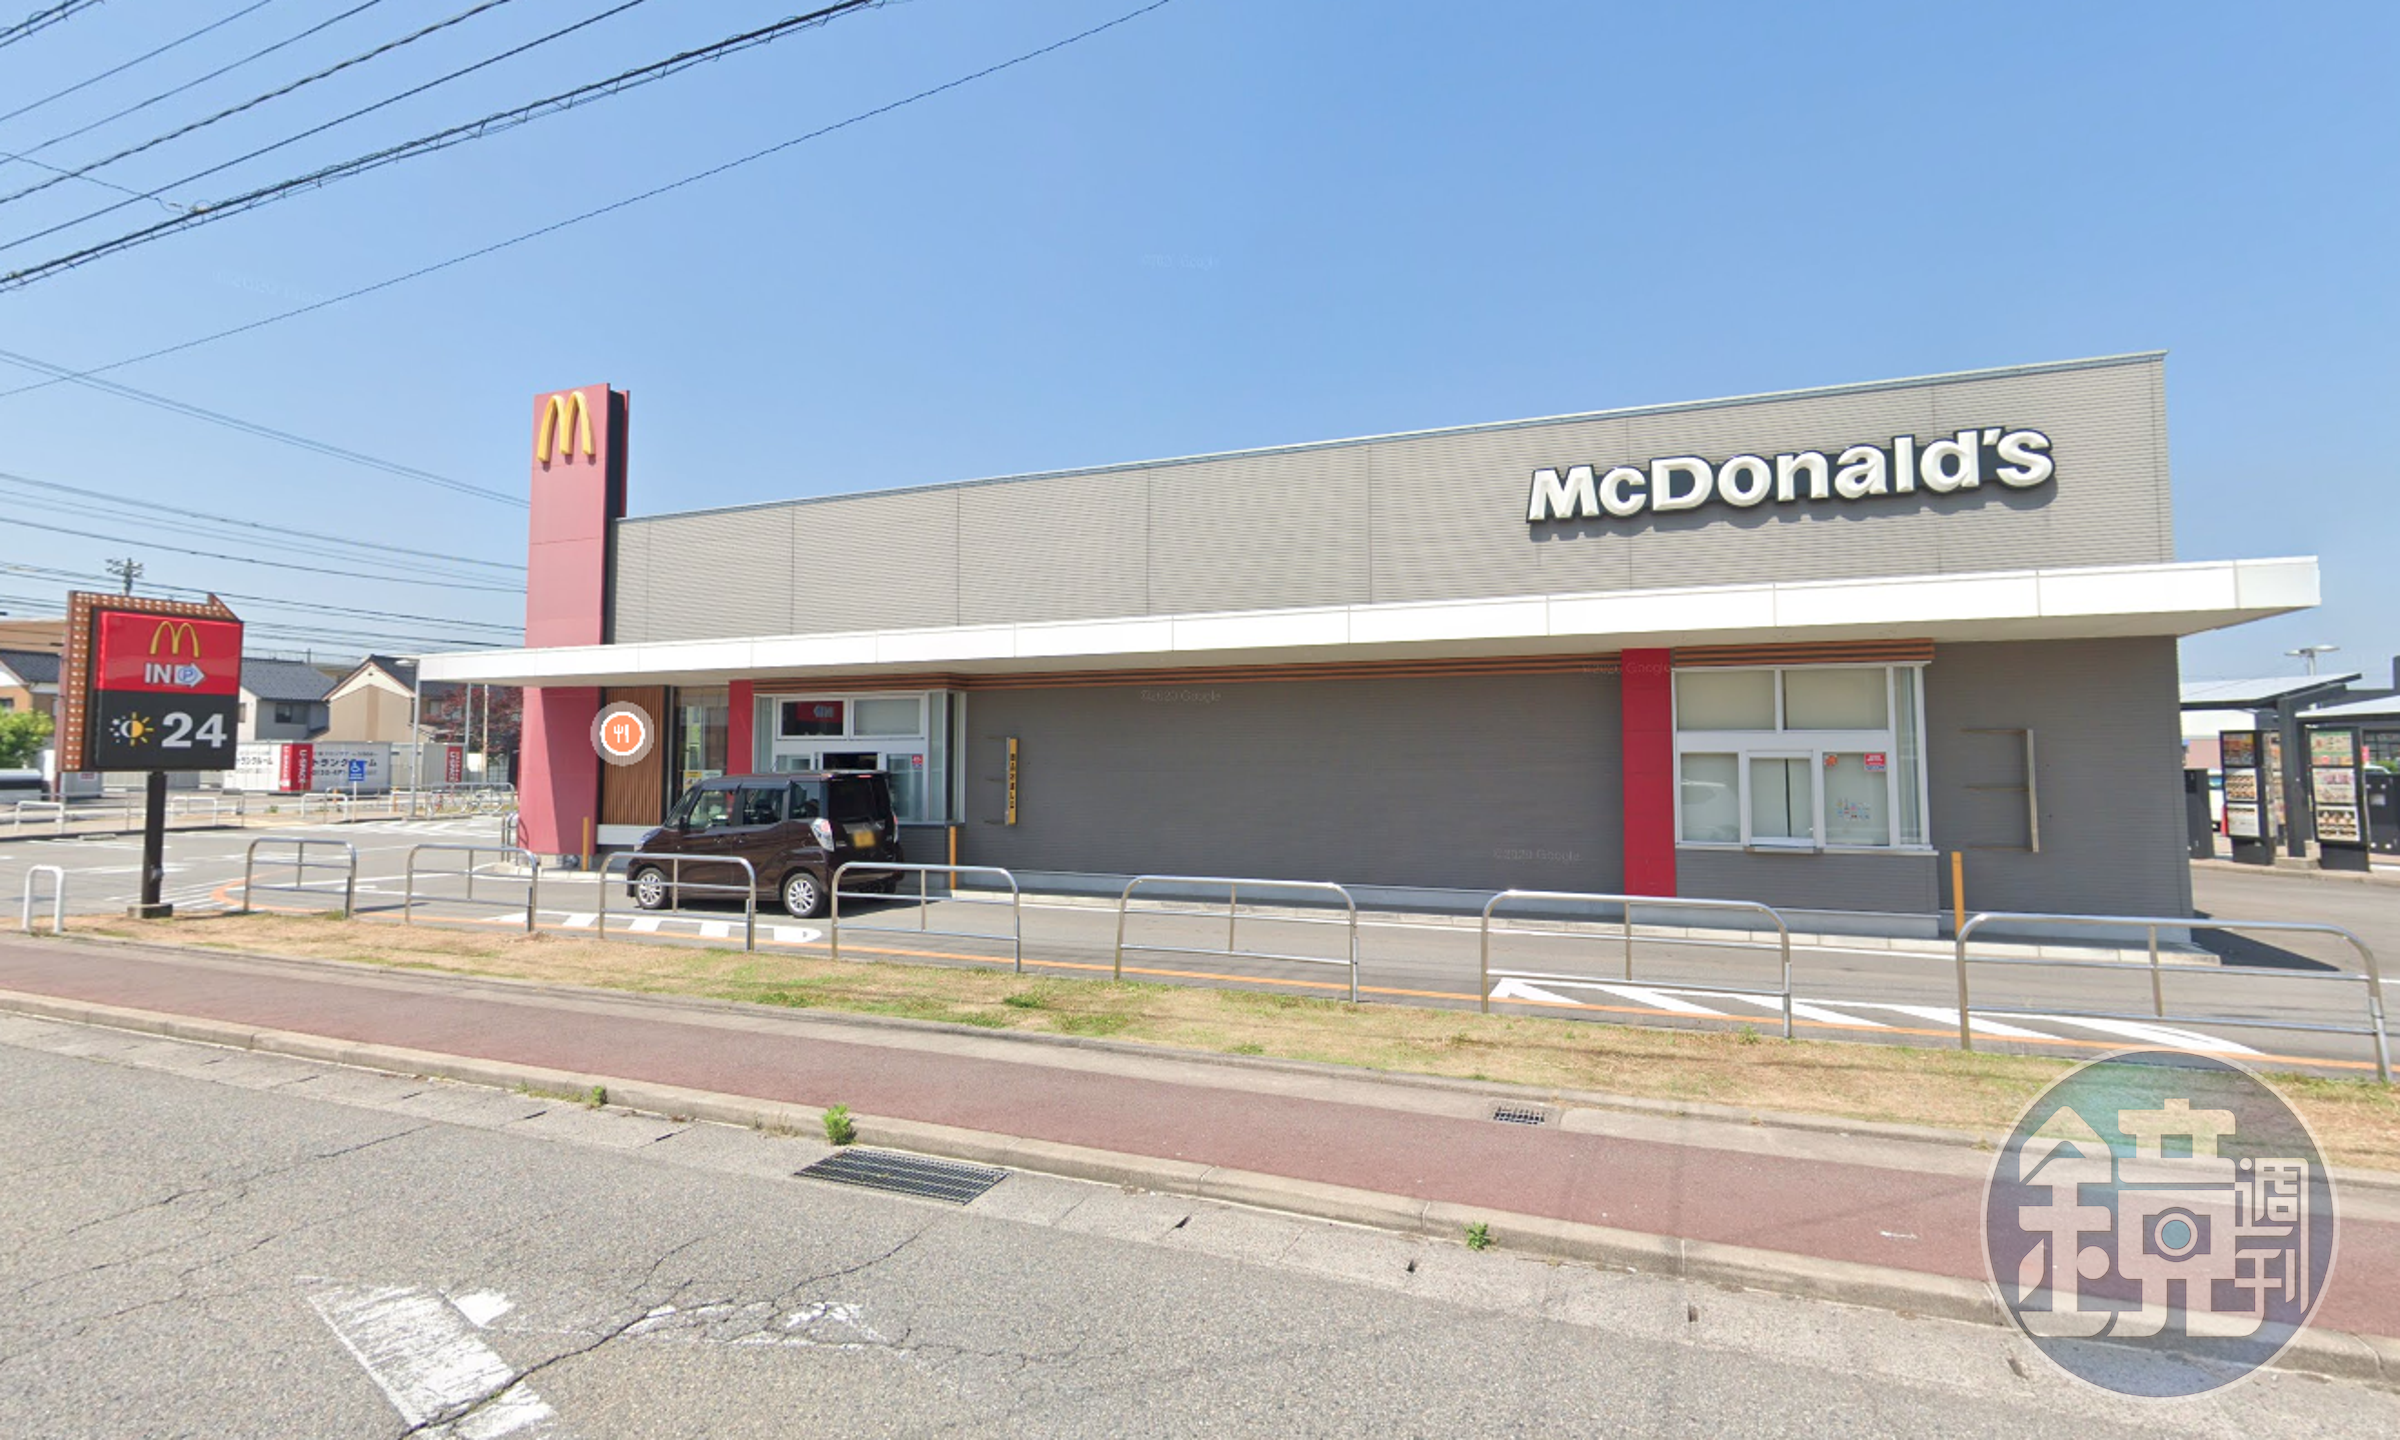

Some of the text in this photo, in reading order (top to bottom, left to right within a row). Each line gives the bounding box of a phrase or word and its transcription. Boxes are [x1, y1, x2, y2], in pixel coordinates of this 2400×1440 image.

[1527, 426, 2055, 523] McDonald's
[144, 662, 172, 684] IN
[161, 711, 228, 748] 24
